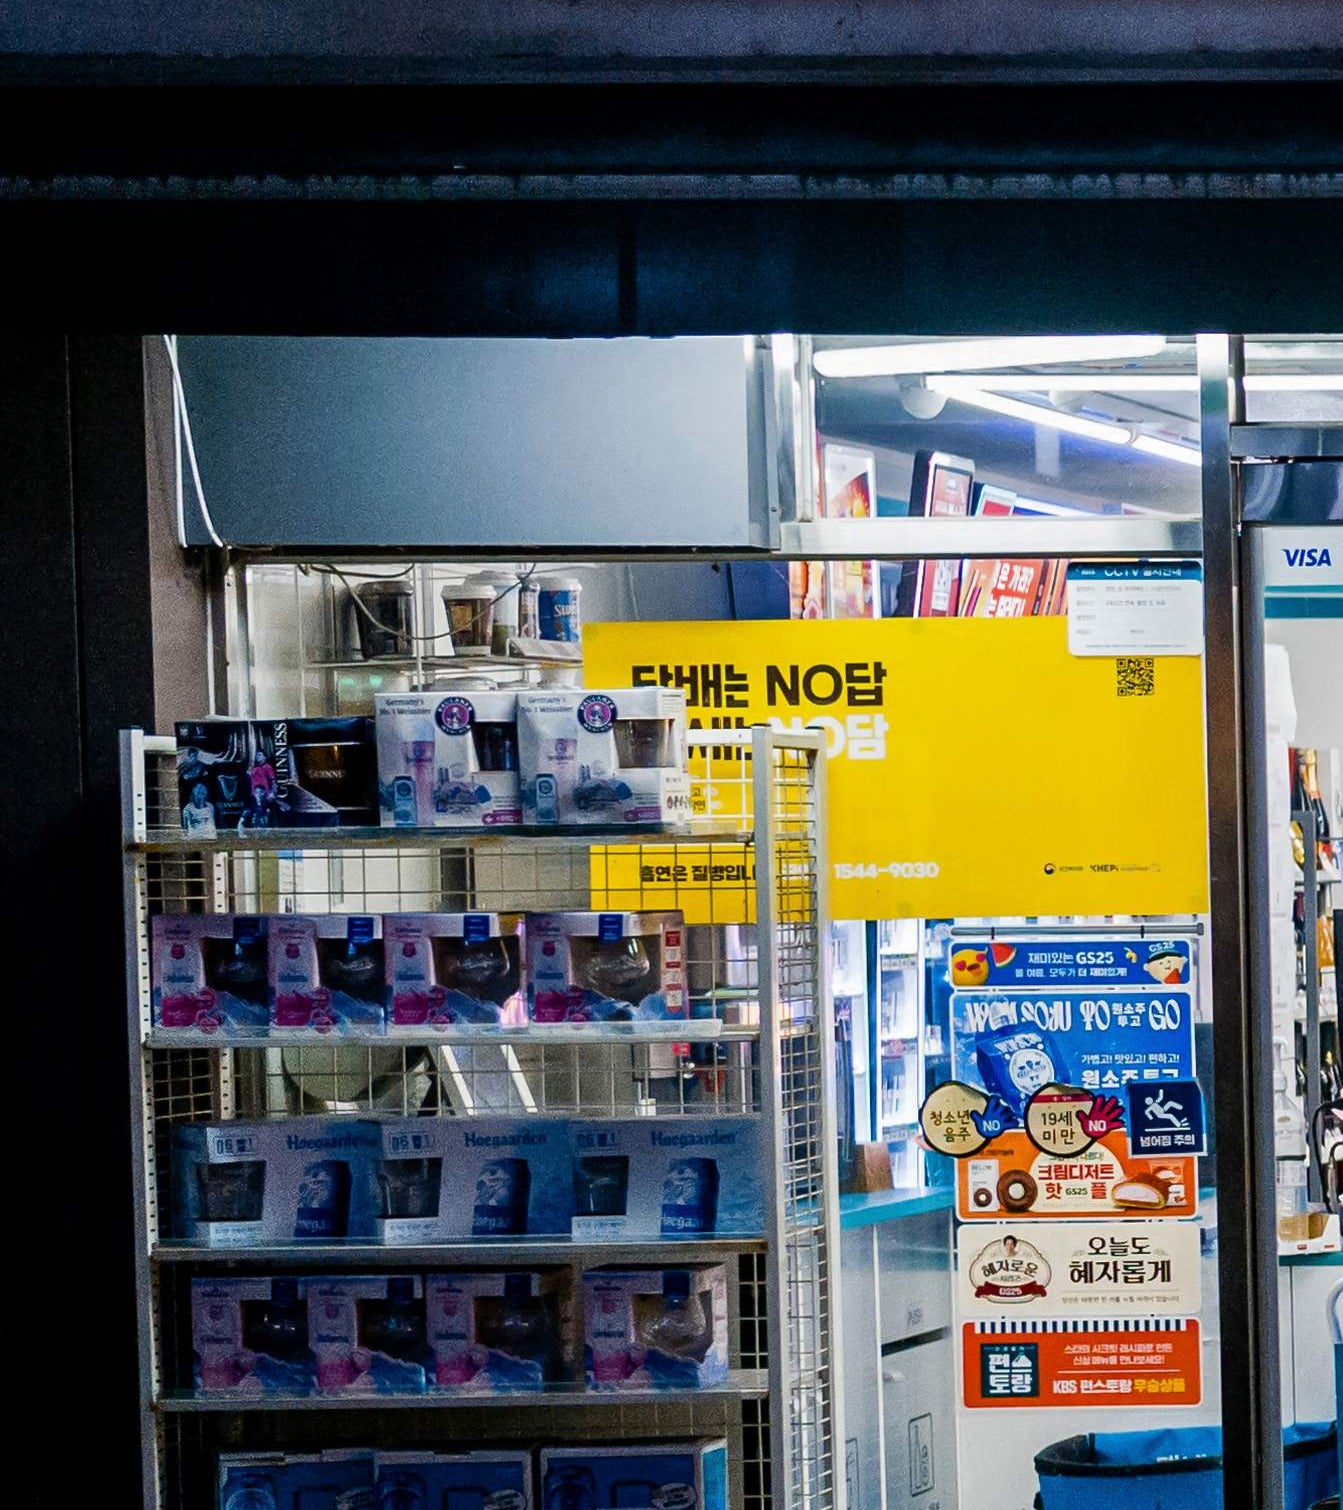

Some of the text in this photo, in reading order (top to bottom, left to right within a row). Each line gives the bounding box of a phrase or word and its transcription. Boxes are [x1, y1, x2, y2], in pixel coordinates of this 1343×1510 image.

[1282, 548, 1332, 568] VISA
[766, 662, 886, 706] NO답
[274, 722, 287, 798] GUINNESS
[833, 861, 939, 880] 1544-9030
[1028, 953, 1114, 964] 재미있는 GS25
[930, 1110, 971, 1126] 청소년
[983, 1120, 1000, 1131] NO
[1042, 1112, 1072, 1126] 19세
[1089, 1120, 1106, 1132] NO
[465, 1131, 547, 1148] Hoegaarden
[652, 1130, 735, 1147] Hoegaarden
[944, 1128, 971, 1142] 음주
[1140, 1135, 1195, 1147] 넘어짐 주의
[1038, 1164, 1114, 1180] 크림디저트
[1046, 1183, 1062, 1199] 핫
[1091, 1183, 1107, 1199] 플
[1088, 1237, 1150, 1256] 오늘도
[983, 1260, 1038, 1278] 혜자로운
[1069, 1260, 1171, 1283] 혜자롭게
[990, 1374, 1032, 1393] 토랑
[1053, 1380, 1077, 1393] KBS
